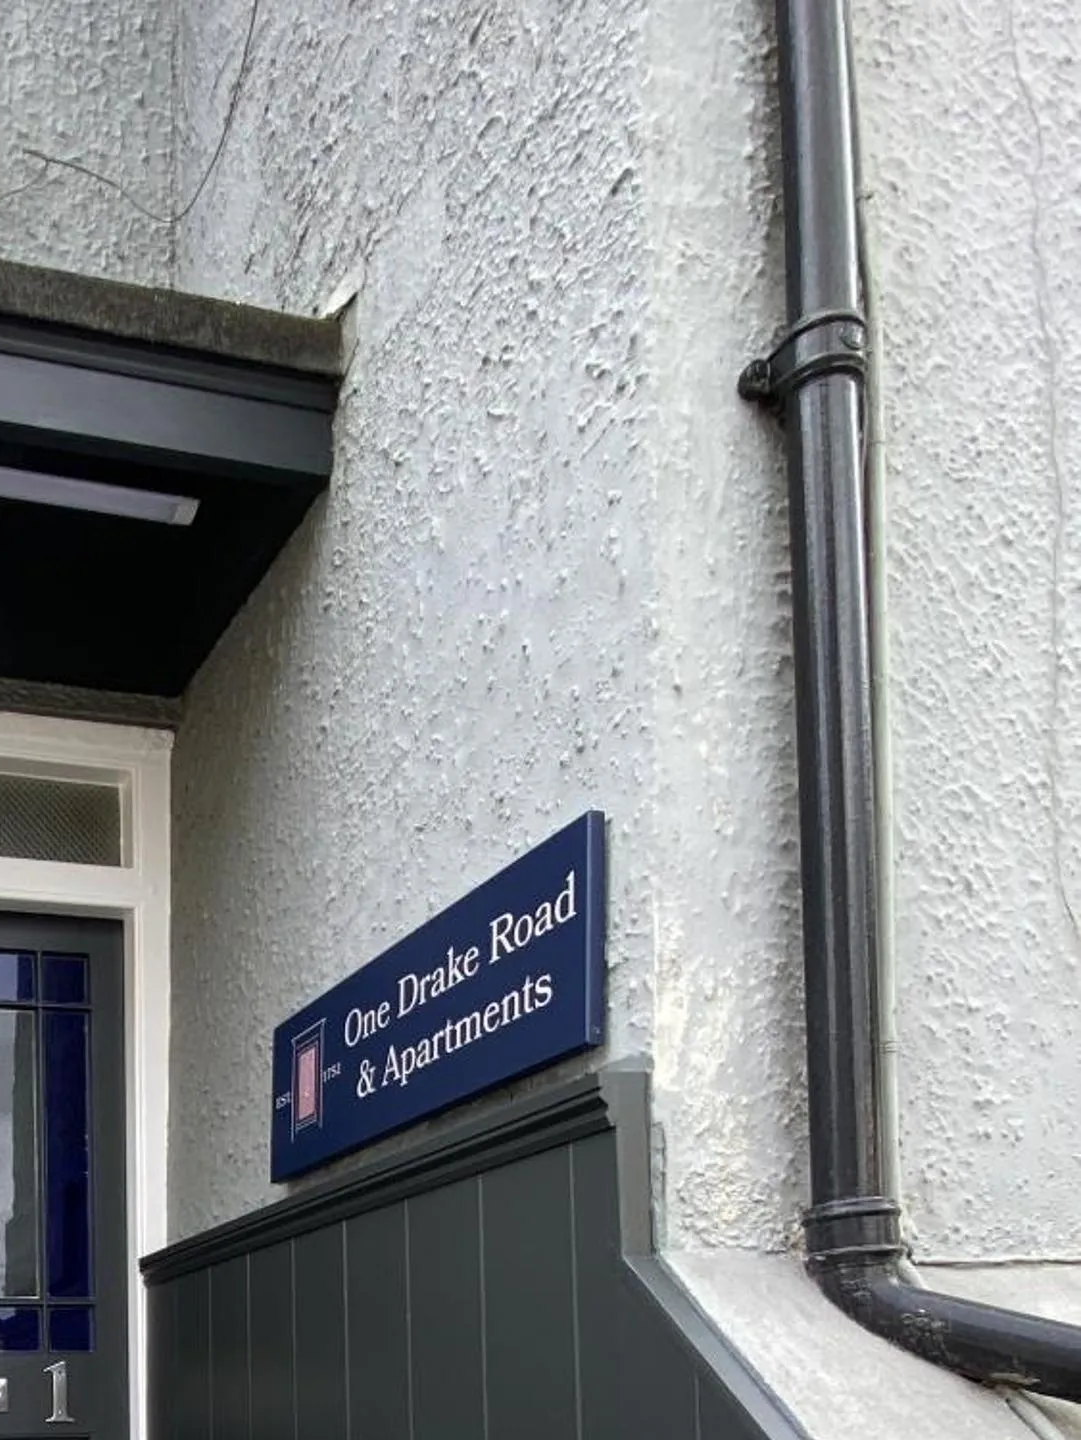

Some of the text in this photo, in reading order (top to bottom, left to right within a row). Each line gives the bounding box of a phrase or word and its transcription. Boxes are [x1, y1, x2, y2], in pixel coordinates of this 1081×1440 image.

[344, 870, 577, 1047] One Drake Road
[356, 973, 554, 1098] & Apartments
[43, 1360, 75, 1423] 1
